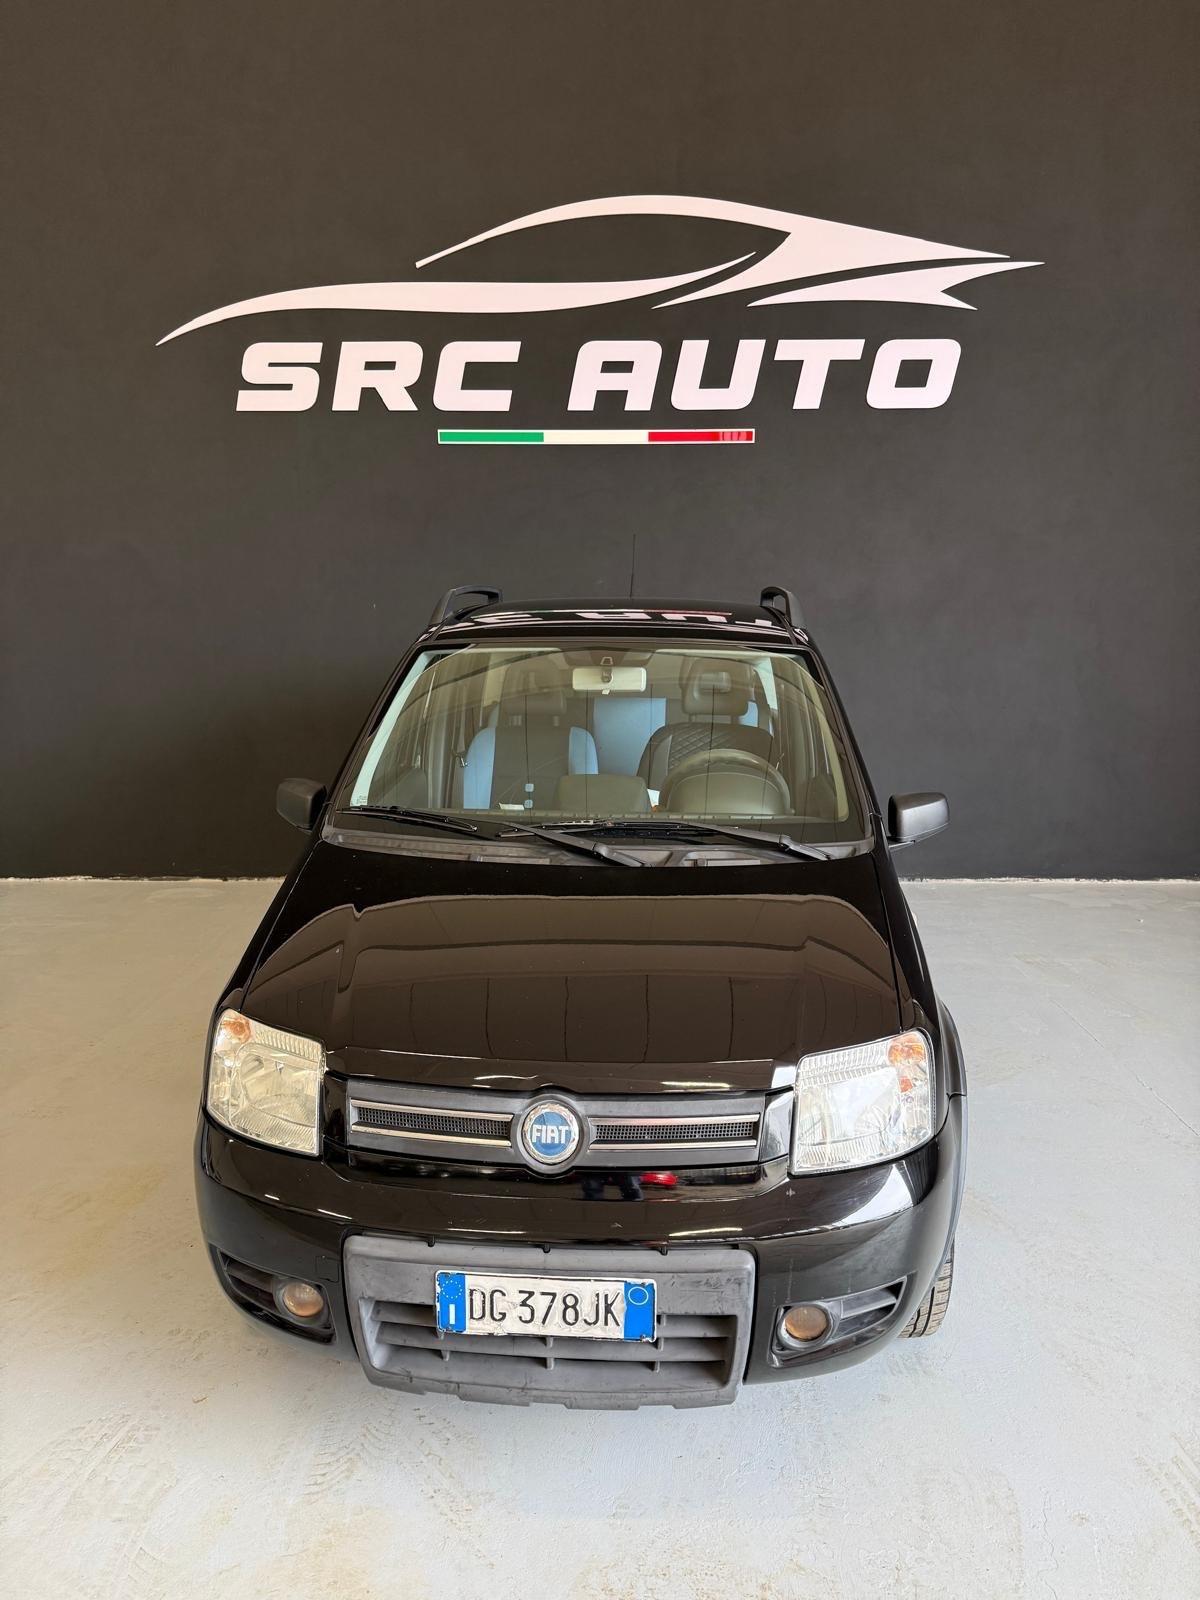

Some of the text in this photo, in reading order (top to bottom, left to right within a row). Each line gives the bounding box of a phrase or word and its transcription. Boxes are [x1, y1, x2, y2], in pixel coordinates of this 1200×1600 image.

[235, 338, 962, 412] SRC AUTO
[531, 1125, 568, 1144] FIAT
